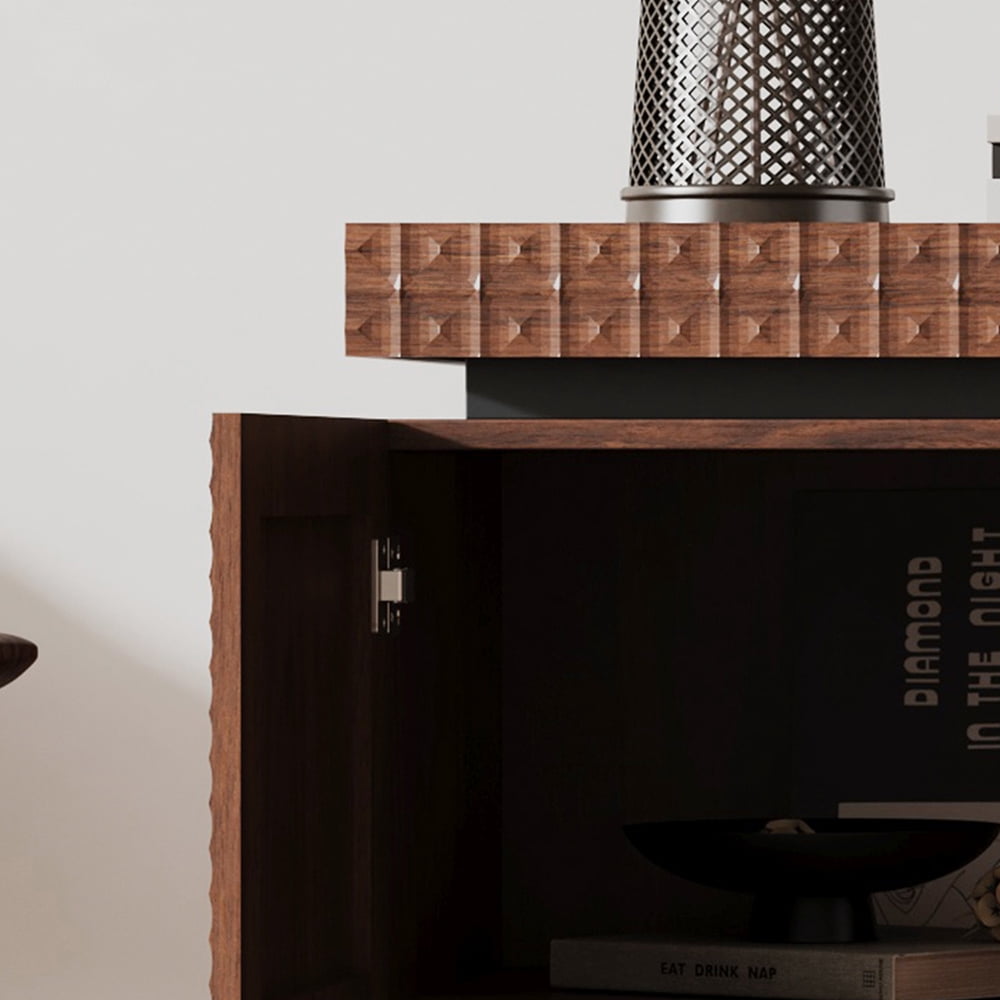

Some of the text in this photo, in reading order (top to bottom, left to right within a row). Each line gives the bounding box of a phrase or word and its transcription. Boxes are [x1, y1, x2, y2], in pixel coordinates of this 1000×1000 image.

[904, 557, 942, 706] DIAMOND
[967, 723, 1000, 749] IN
[661, 962, 776, 979] EAT DRINK NAP
